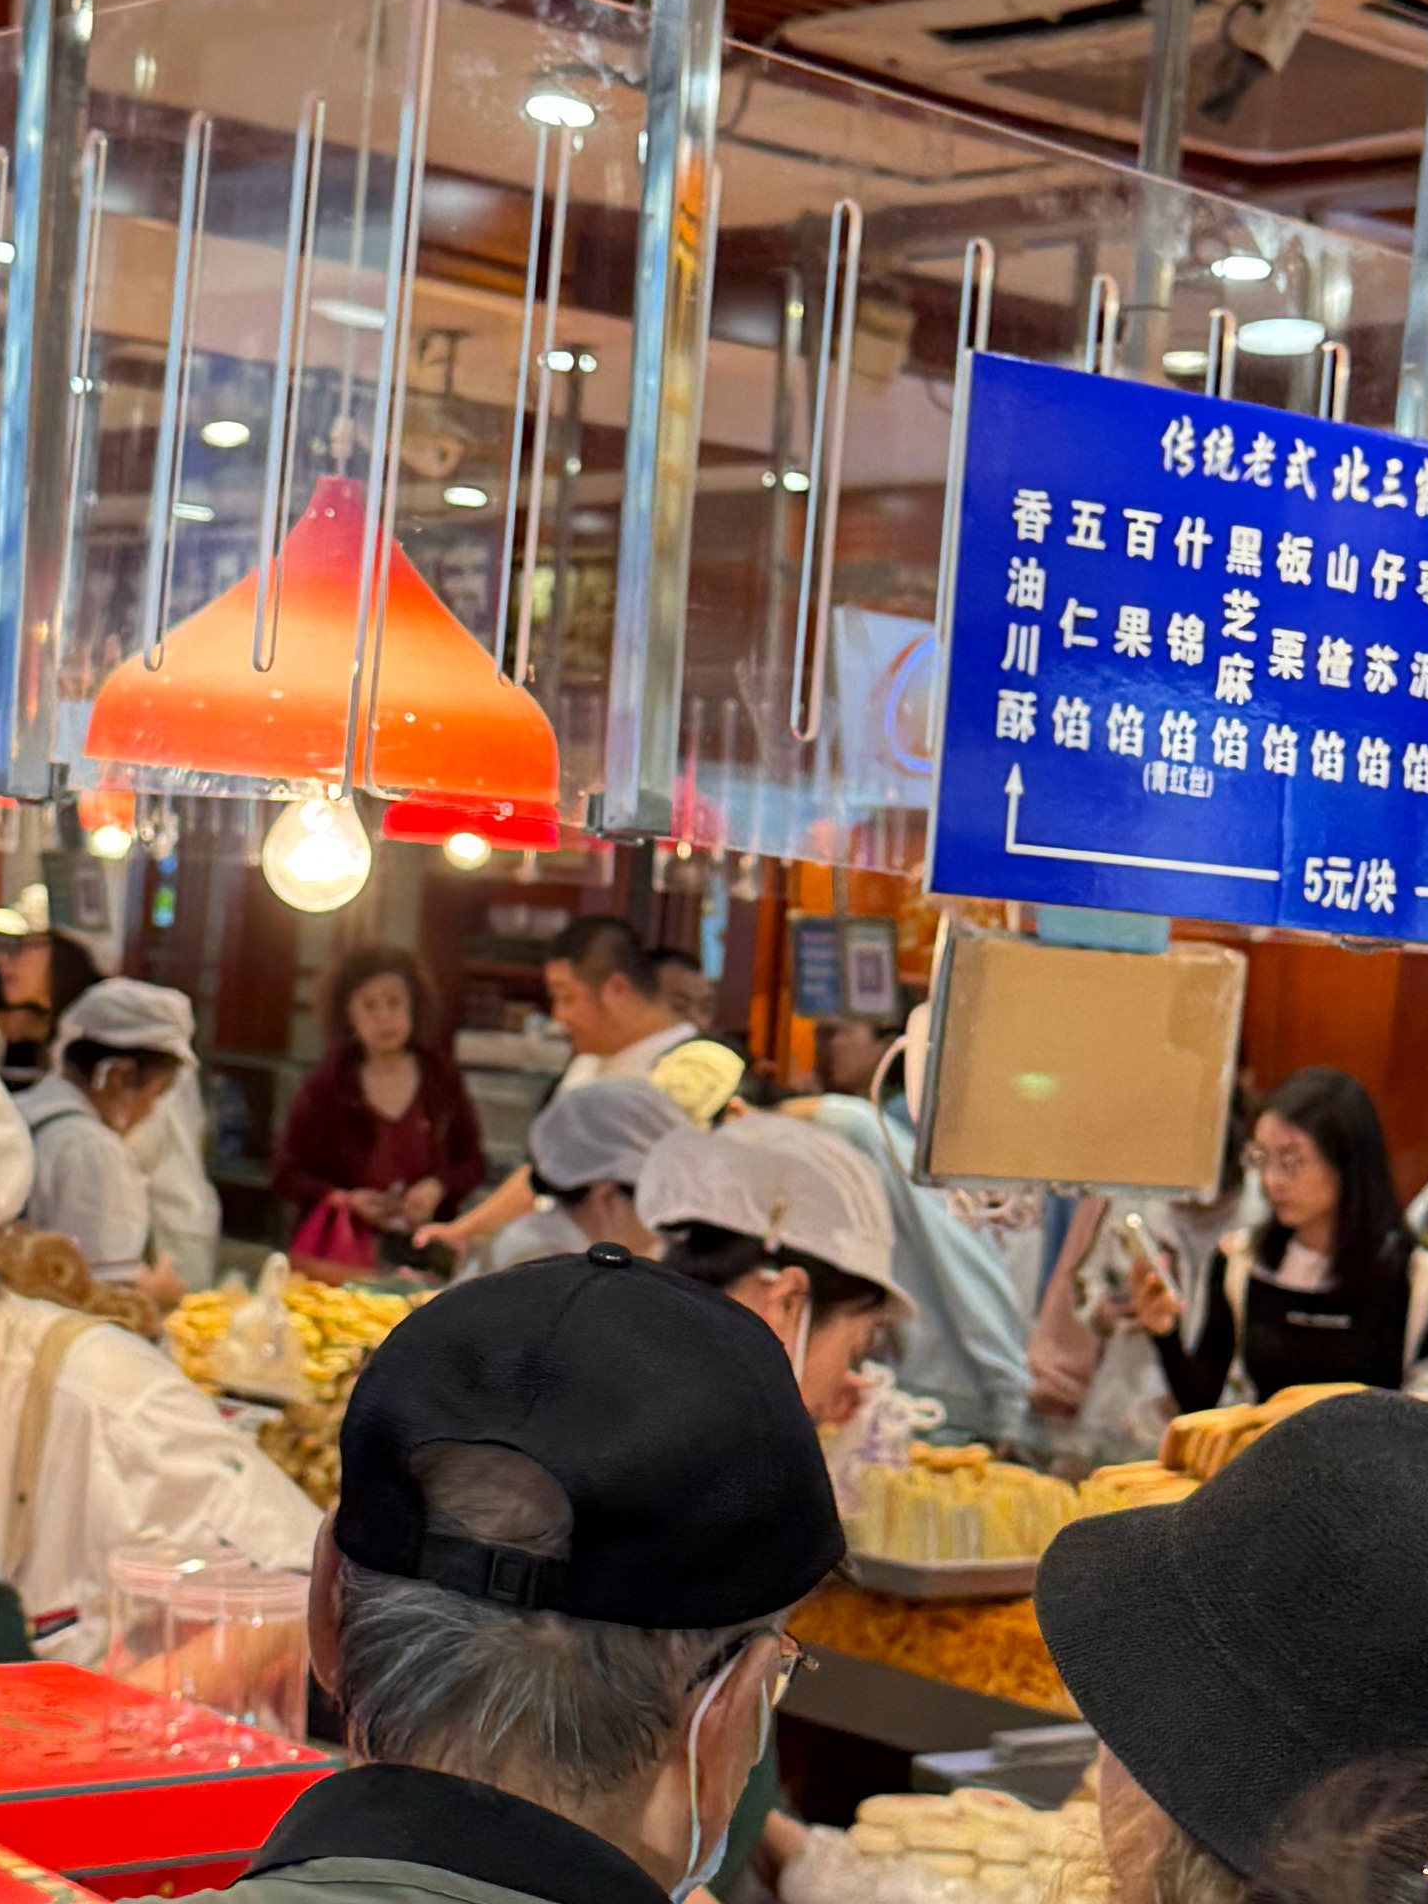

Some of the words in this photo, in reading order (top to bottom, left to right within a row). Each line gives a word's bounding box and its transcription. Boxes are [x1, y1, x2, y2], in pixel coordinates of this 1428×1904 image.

[1160, 414, 1317, 501] 传统老式
[1303, 856, 1397, 913] 5元/块
